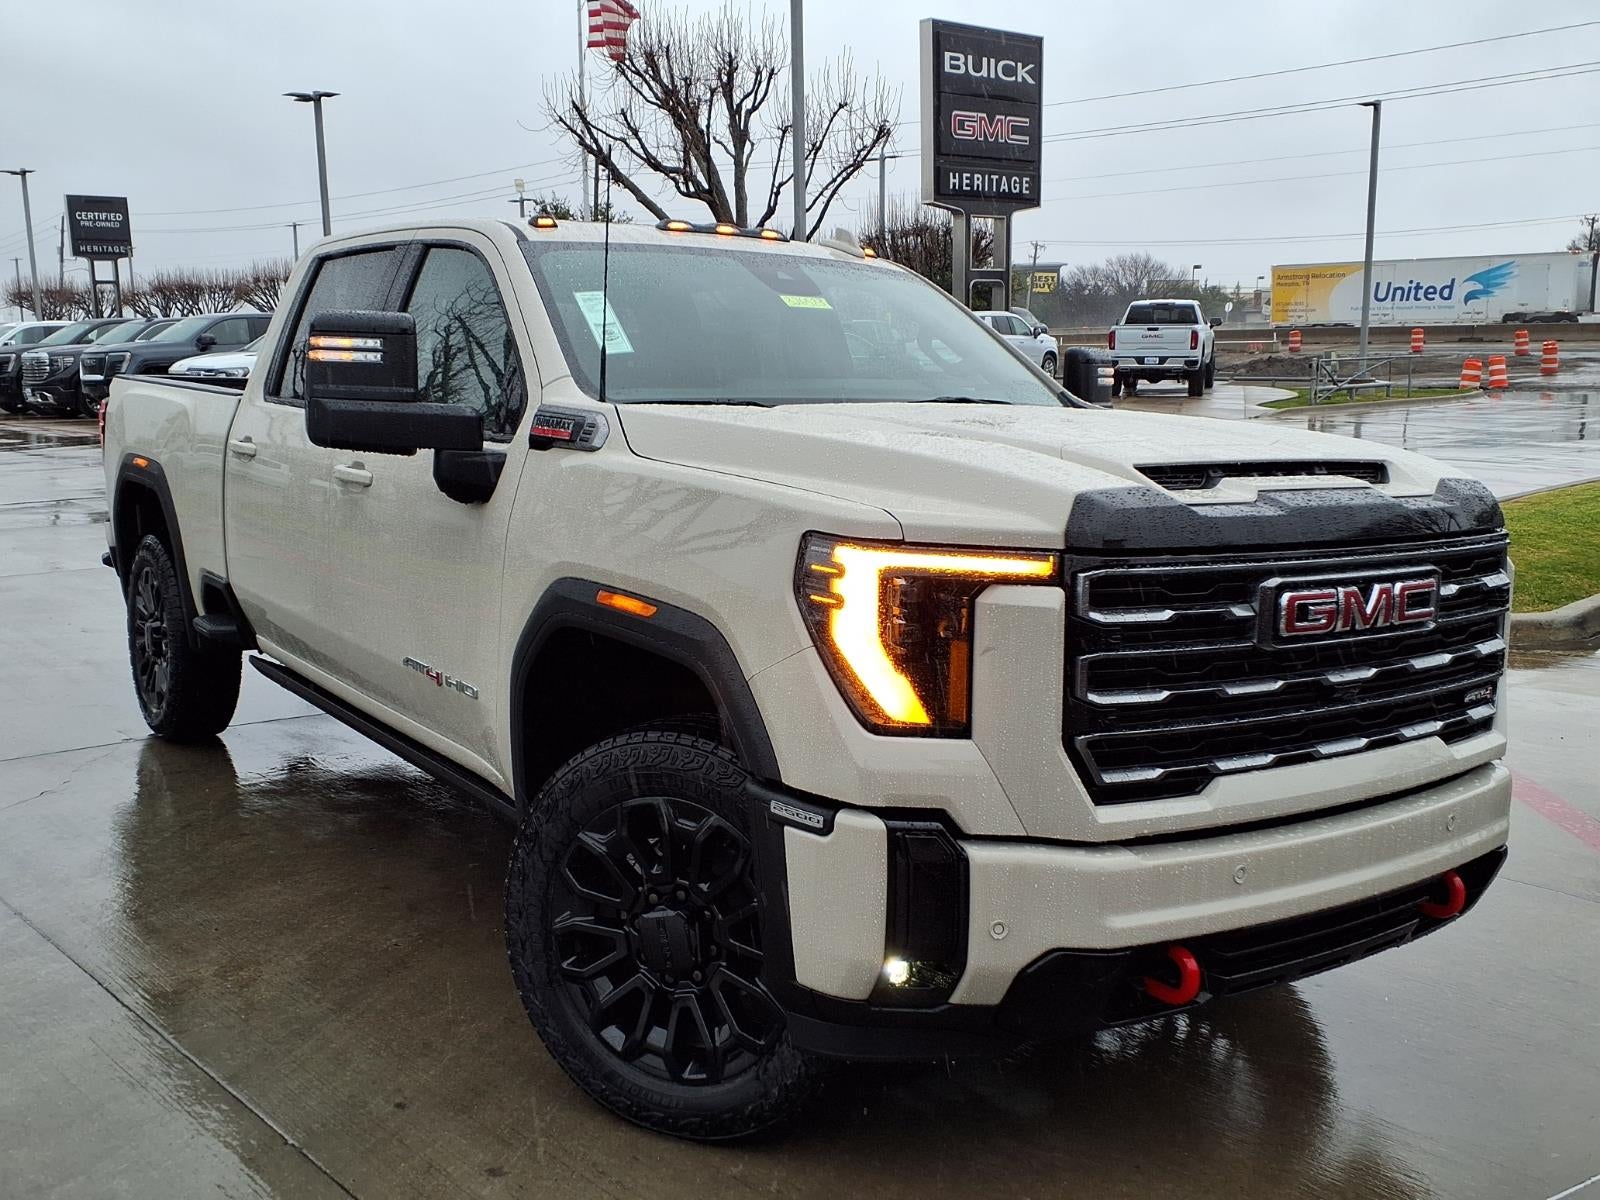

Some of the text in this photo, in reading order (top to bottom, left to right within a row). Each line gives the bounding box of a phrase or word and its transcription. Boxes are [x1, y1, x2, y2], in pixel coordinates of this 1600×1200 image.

[944, 51, 1036, 84] BUICK
[951, 110, 1030, 145] GMC
[949, 172, 1031, 194] HERITAGE
[75, 211, 123, 221] CERTIFIED
[80, 220, 120, 228] PRE-OWNED
[79, 245, 127, 253] HERITAGE
[1032, 282, 1052, 290] BUY
[1373, 278, 1456, 302] United
[1280, 578, 1437, 637] GMC
[772, 802, 822, 827] 2500
